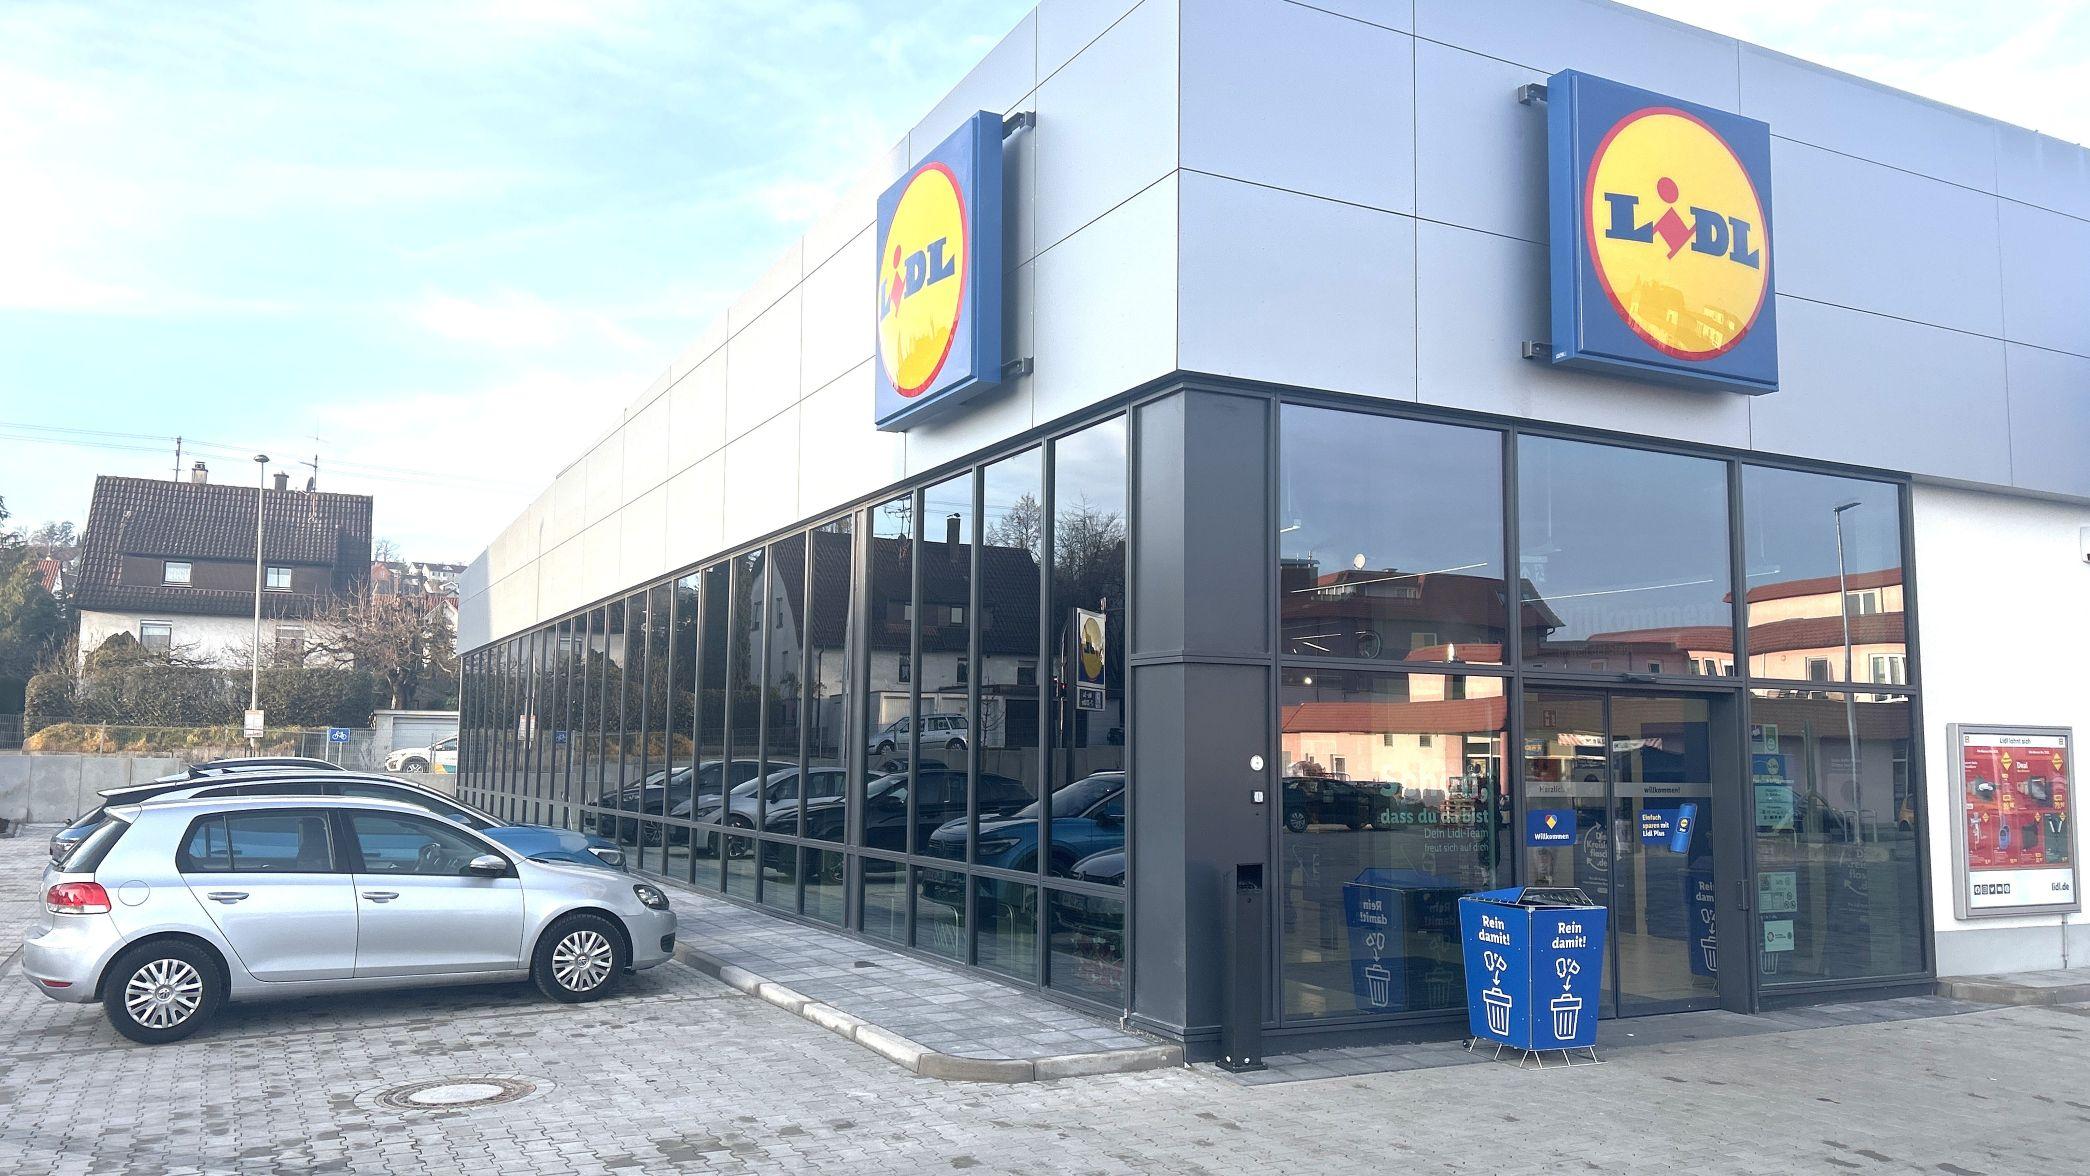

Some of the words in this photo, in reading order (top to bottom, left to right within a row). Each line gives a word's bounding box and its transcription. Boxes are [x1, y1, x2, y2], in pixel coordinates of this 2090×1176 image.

[1644, 786, 1681, 794] willkommen!
[1380, 808, 1414, 824] dass
[1418, 808, 1437, 823] du
[1441, 808, 1459, 824] da
[1460, 808, 1489, 823] bist
[1424, 828, 1445, 839] Dein
[1447, 828, 1489, 840] Lidl-Team
[1424, 843, 1442, 853] freut
[1443, 843, 1457, 852] sich
[1473, 842, 1489, 852] dich
[1698, 881, 1714, 891] Rei
[2051, 882, 2070, 891] lidl.de
[1695, 892, 1714, 902] dam
[1481, 915, 1505, 930] Rein
[1557, 921, 1582, 934] Rein
[1478, 929, 1511, 946] damit!
[1552, 936, 1587, 949] damit!
